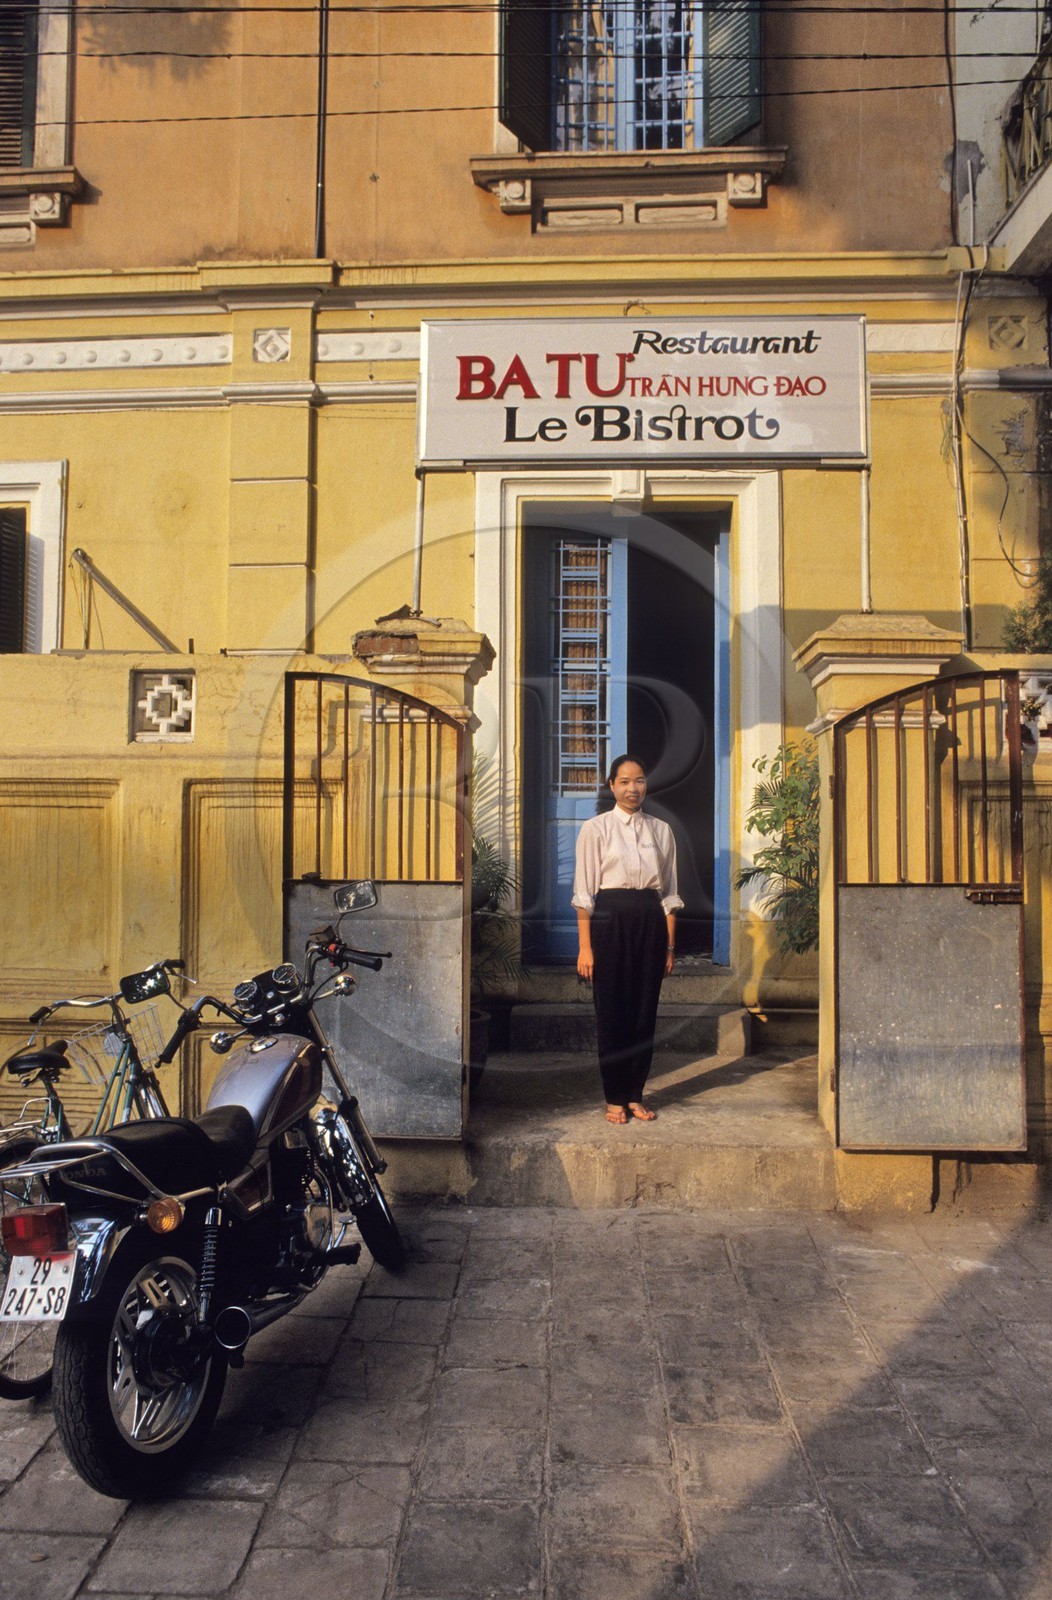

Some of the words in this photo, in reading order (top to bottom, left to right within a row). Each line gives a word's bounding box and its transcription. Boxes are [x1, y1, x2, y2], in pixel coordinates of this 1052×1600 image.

[633, 330, 822, 354] Restaurant
[456, 353, 541, 400] BA
[503, 406, 568, 442] Le
[575, 404, 780, 442] Bistrot
[30, 1256, 52, 1286] 29
